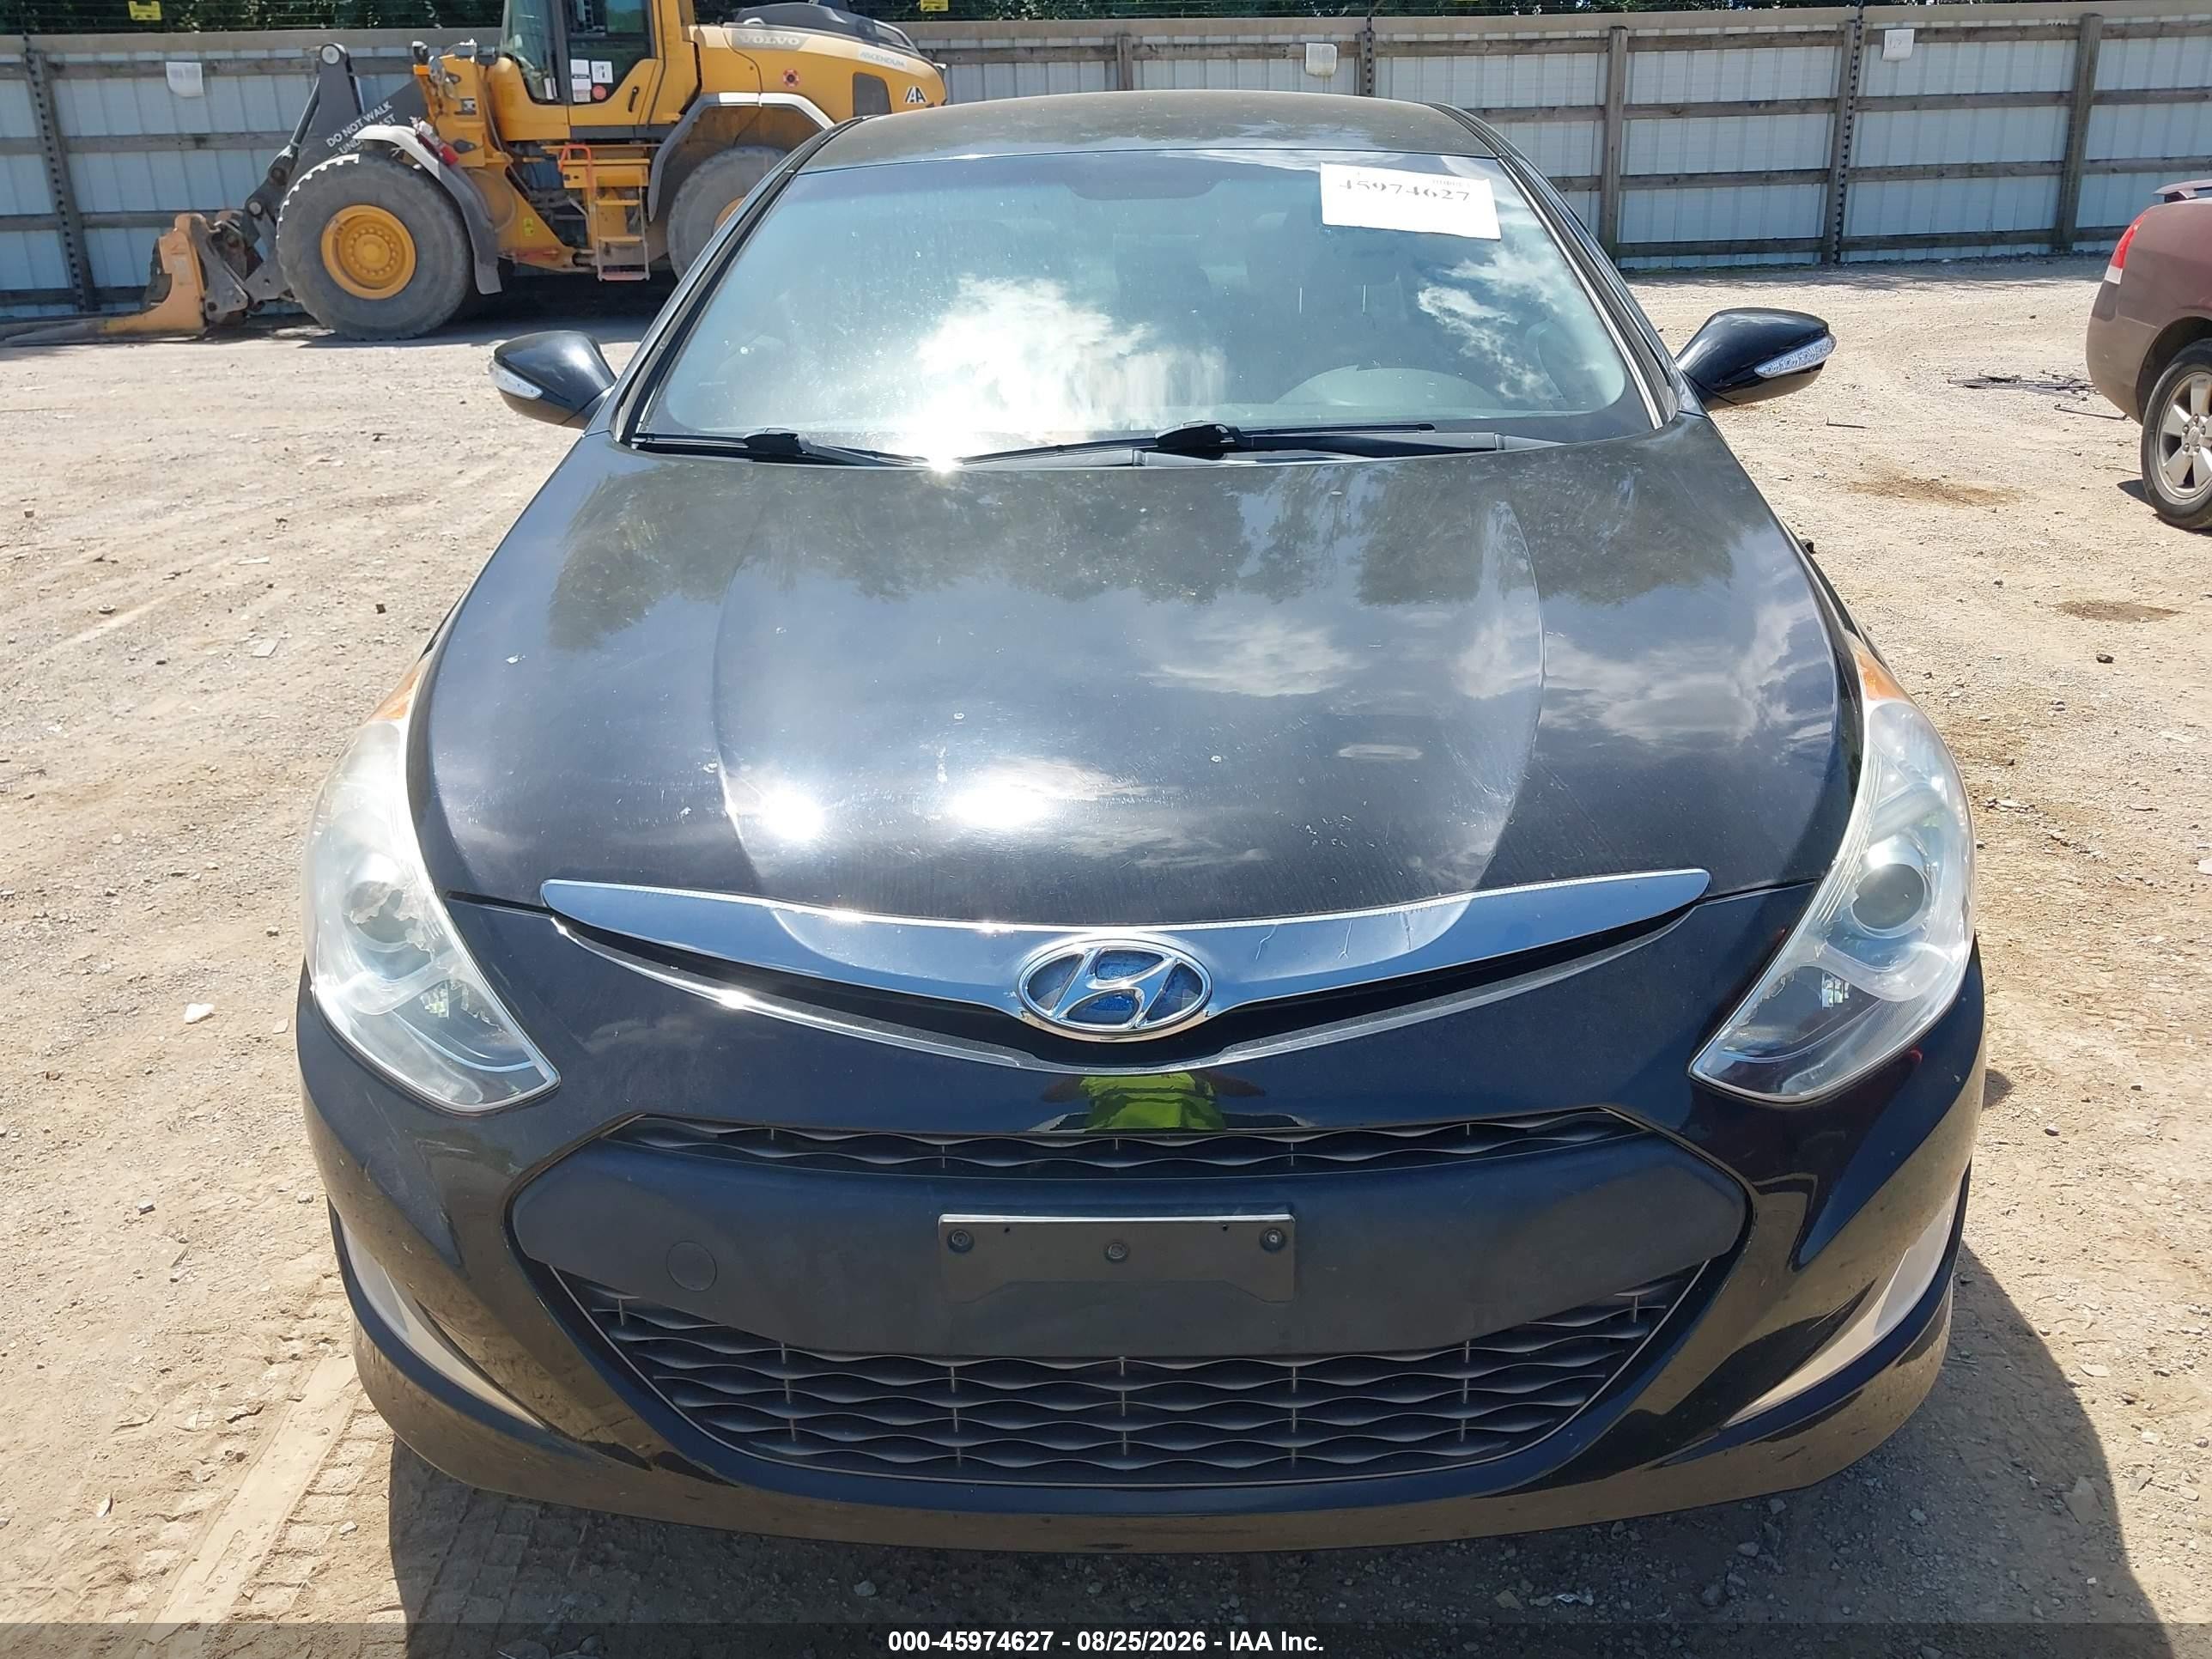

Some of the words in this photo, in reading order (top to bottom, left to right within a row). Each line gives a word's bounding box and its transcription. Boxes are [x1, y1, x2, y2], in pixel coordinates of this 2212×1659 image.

[739, 35, 800, 46] VOLVO
[326, 133, 343, 148] DO
[341, 118, 364, 137] NOT
[363, 100, 393, 123] WALK
